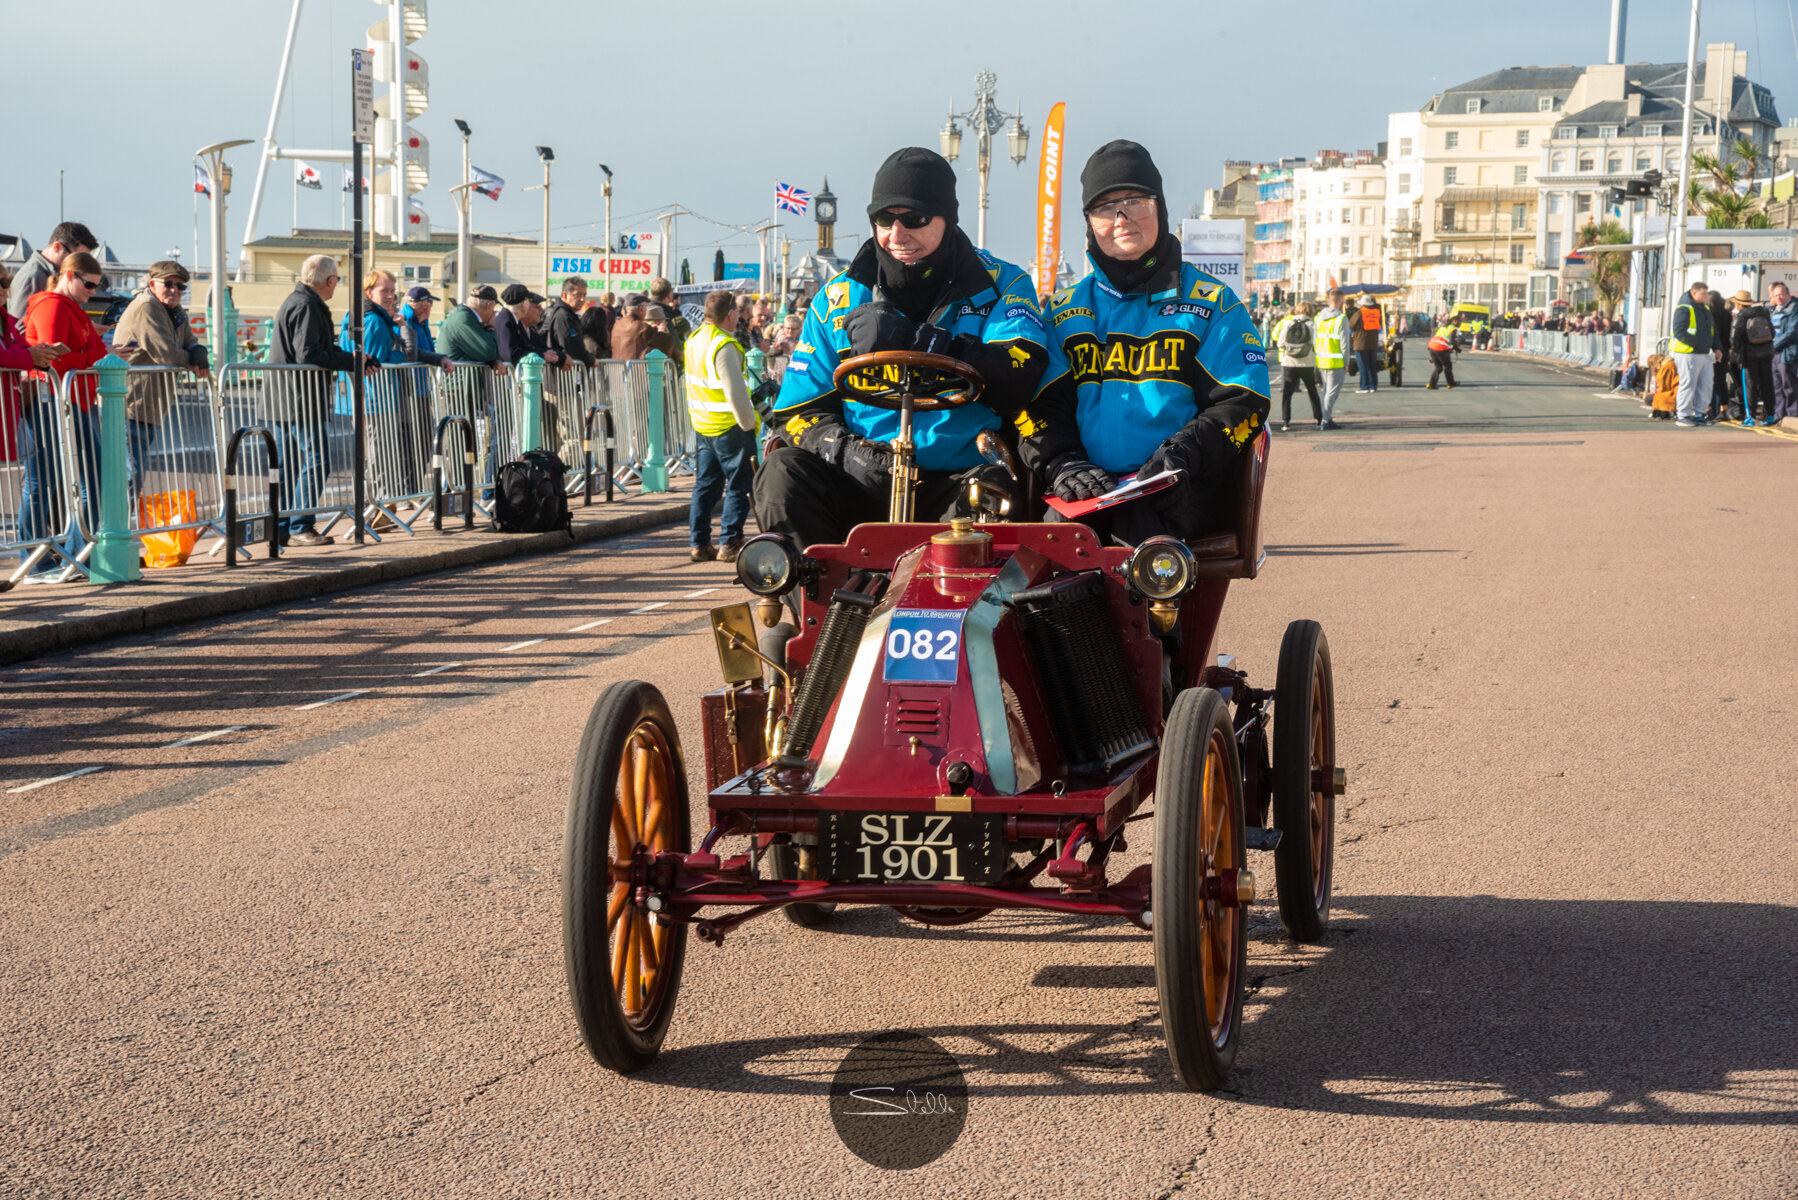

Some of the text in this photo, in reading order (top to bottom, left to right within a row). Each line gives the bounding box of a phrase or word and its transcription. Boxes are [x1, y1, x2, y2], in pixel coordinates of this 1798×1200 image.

[1045, 125, 1060, 198] POINT
[620, 234, 653, 250] £6.50
[552, 257, 651, 275] FISH CHIPS
[1784, 273, 1797, 281] T01
[620, 280, 651, 290] PEAS
[1179, 304, 1211, 319] GURU
[888, 628, 958, 660] 082
[830, 814, 838, 876] Renault
[860, 814, 953, 846] SLZ
[982, 821, 991, 857] Type
[856, 845, 965, 881] 1901
